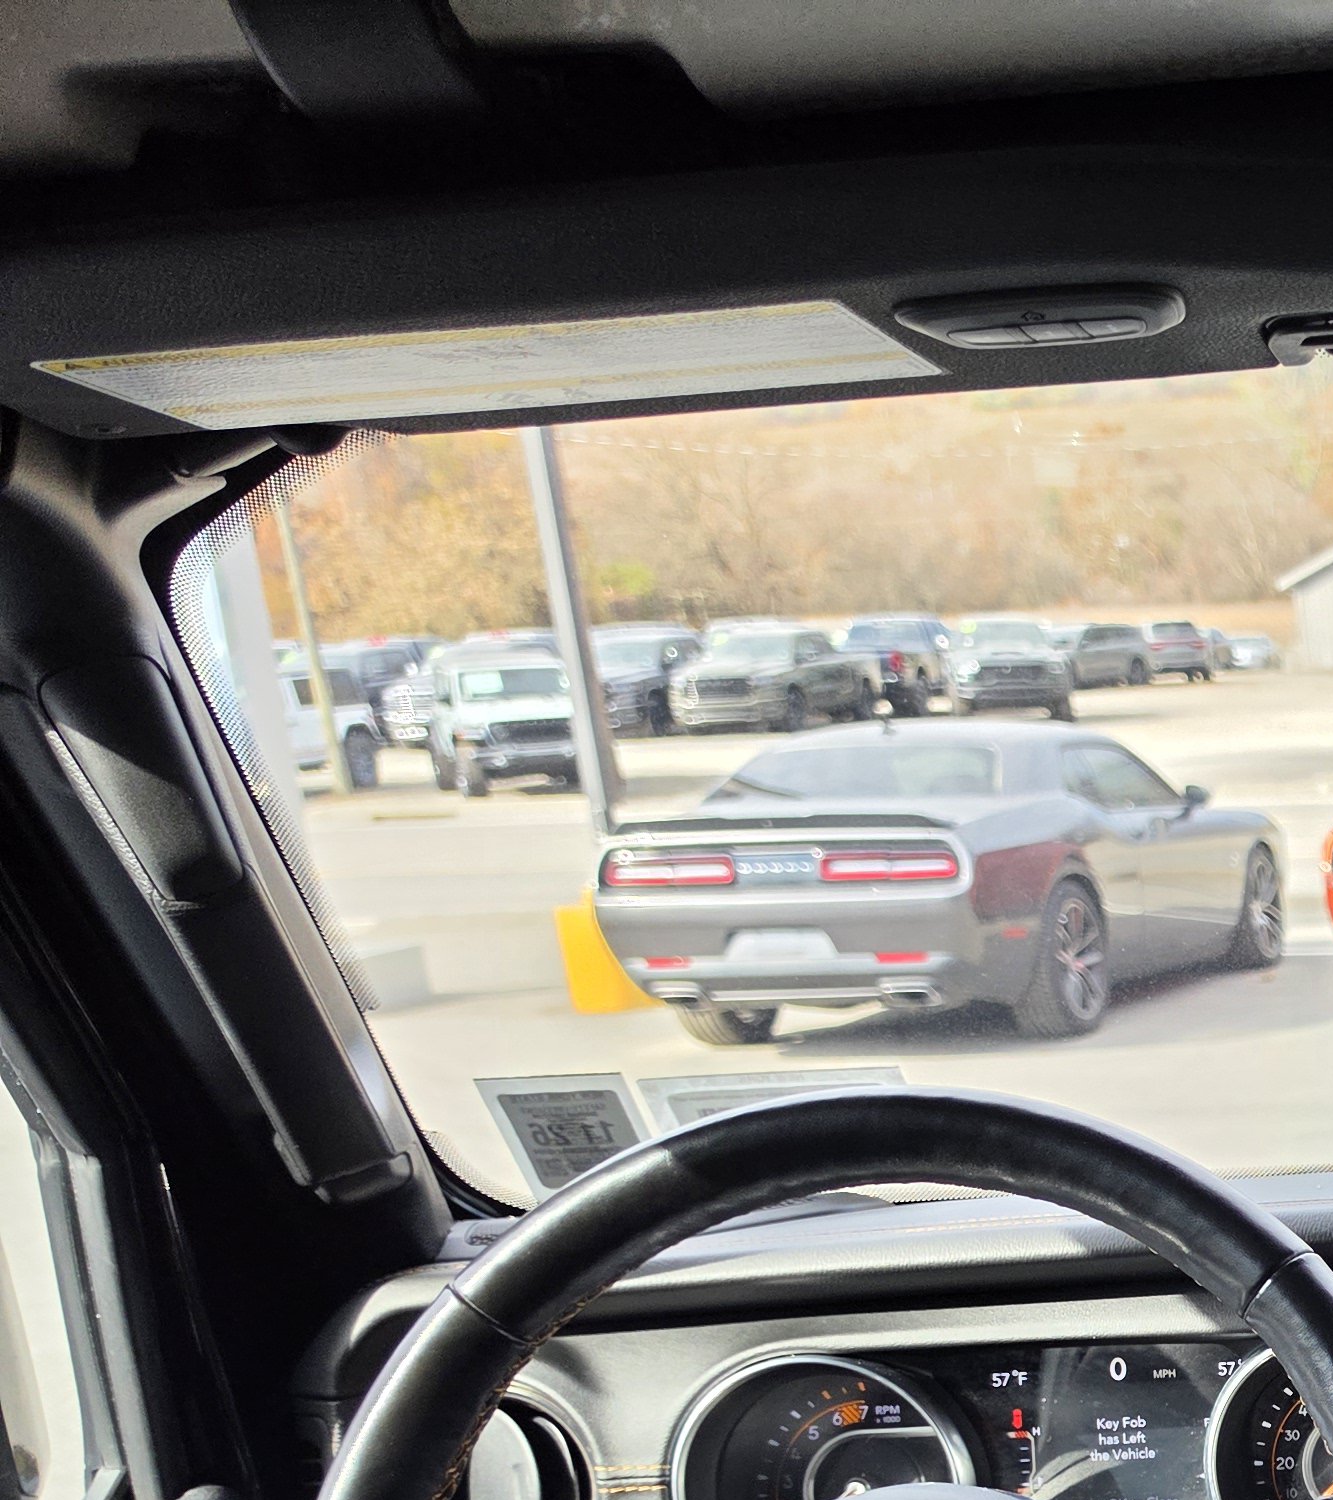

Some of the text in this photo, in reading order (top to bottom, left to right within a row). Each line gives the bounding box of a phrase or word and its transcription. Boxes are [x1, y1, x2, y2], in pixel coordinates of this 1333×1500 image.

[1109, 1357, 1177, 1381] 0 MPH
[992, 1370, 1028, 1388] 57°F
[859, 1405, 869, 1420] 7
[875, 1405, 900, 1415] RPM
[1298, 1403, 1308, 1417] 4
[832, 1412, 842, 1426] 6
[1097, 1415, 1147, 1432] Key Fob
[808, 1426, 819, 1440] 5
[1099, 1431, 1146, 1445] has Left
[1284, 1429, 1300, 1441] 30
[1090, 1448, 1156, 1462] the Vehicle
[1276, 1456, 1295, 1470] 20
[1286, 1487, 1298, 1499] 10
